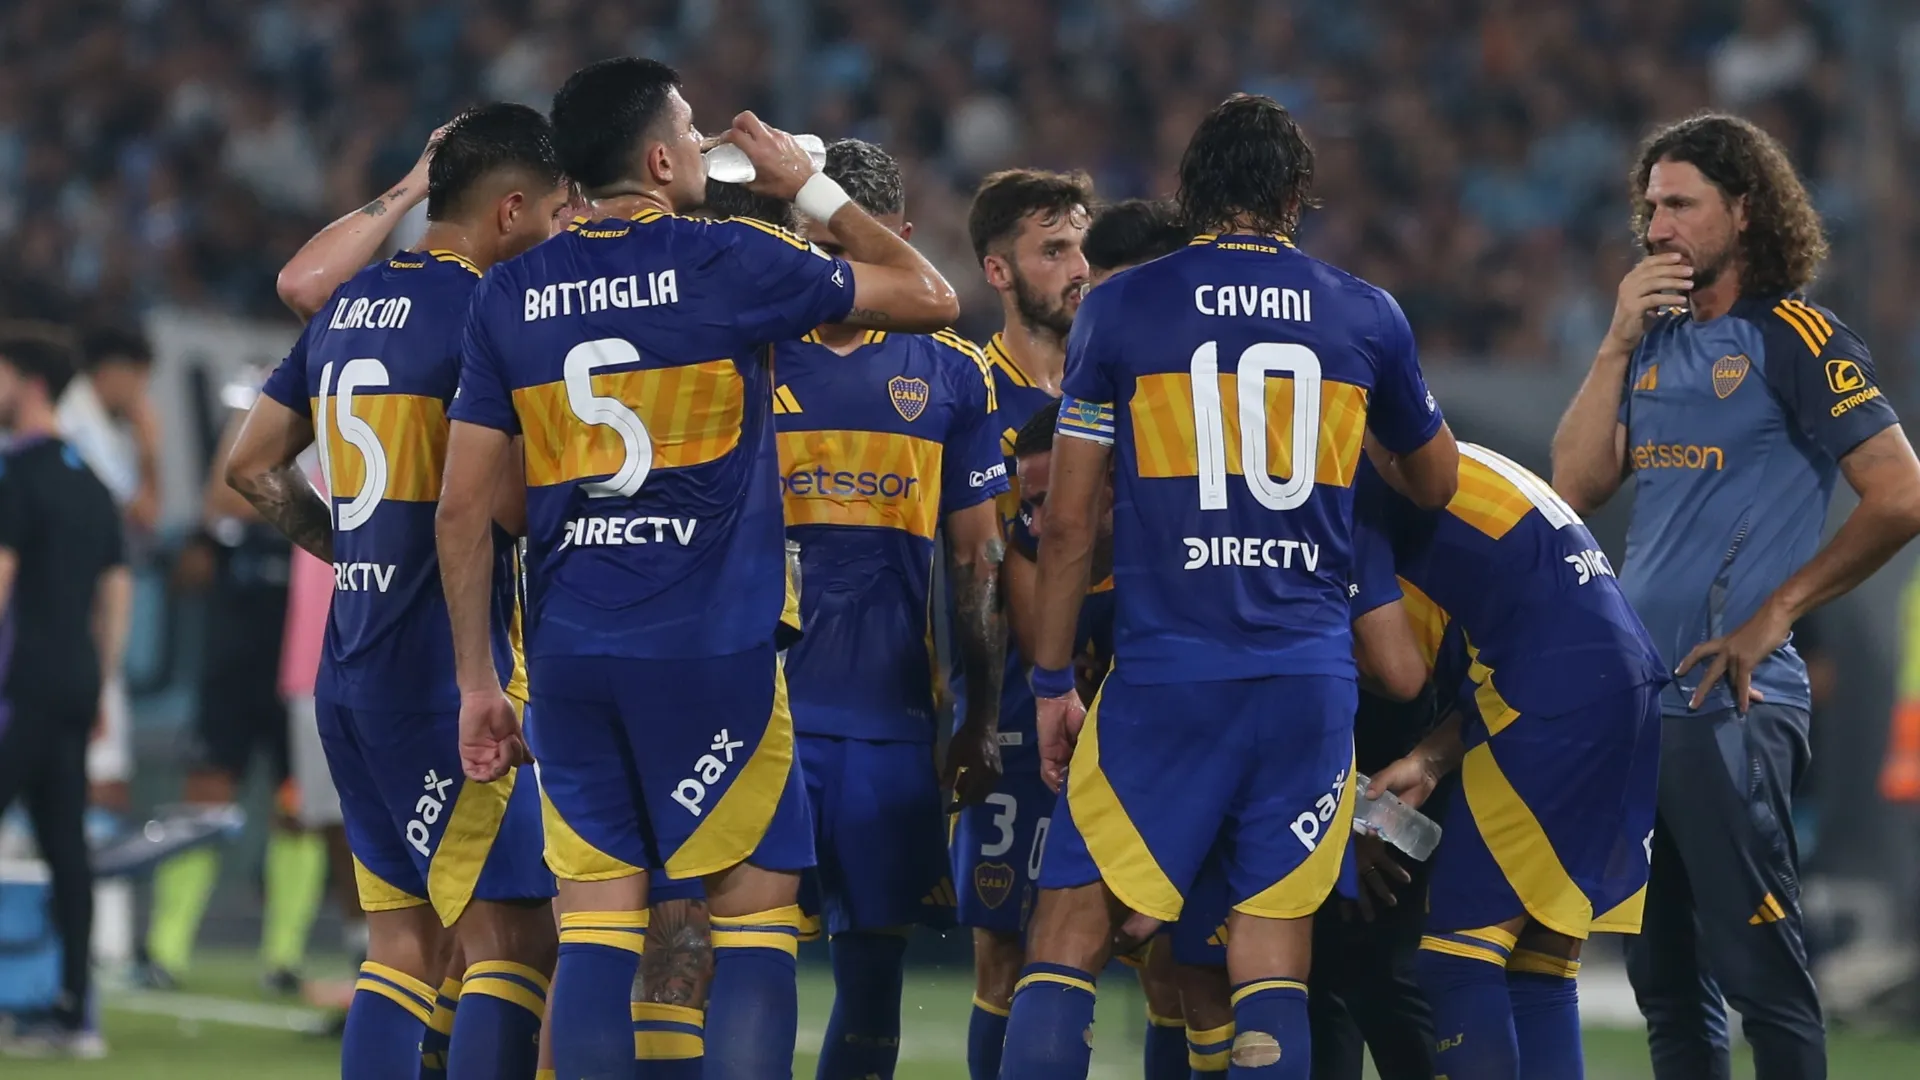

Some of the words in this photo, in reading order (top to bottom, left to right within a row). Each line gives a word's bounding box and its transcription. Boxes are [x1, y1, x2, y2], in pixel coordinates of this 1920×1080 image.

[1217, 243, 1277, 254] XENEIZE
[328, 296, 411, 329] LARCON
[524, 269, 678, 321] BATTAGLIA
[1195, 285, 1311, 322] CAVANI
[1716, 368, 1742, 379] CABJ
[894, 390, 923, 401] CABJ
[564, 338, 652, 498] 5
[1190, 340, 1322, 511] 10
[317, 358, 389, 531] 15
[1632, 439, 1723, 471] etsson
[557, 517, 697, 552] DIRECTV
[1183, 536, 1319, 573] DIRECTV
[333, 562, 396, 592] RECTV
[671, 729, 743, 816] pax
[405, 770, 453, 857] pax
[981, 793, 1017, 856] 3
[1290, 769, 1346, 852] pax
[978, 878, 1008, 888] CABJ
